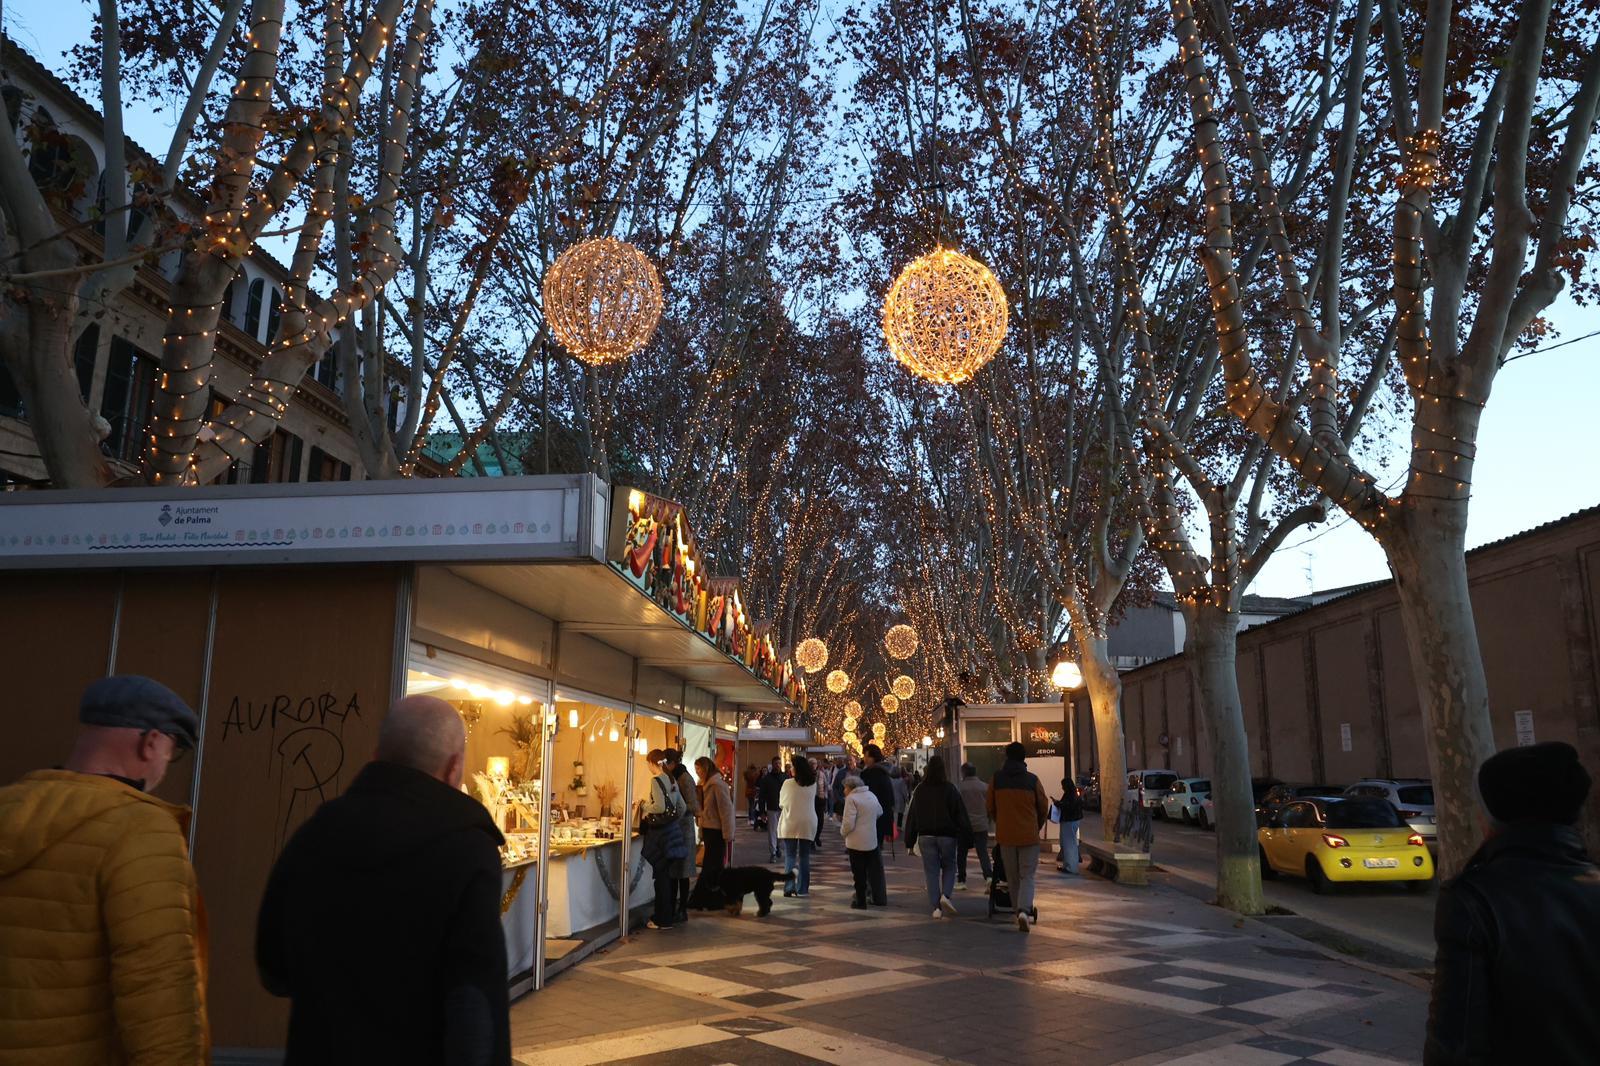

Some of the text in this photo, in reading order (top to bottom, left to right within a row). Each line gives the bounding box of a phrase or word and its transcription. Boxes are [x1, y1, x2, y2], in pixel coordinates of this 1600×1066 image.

[175, 506, 218, 515] Ajuntament
[174, 516, 211, 524] de Palma
[222, 692, 361, 742] AURORA
